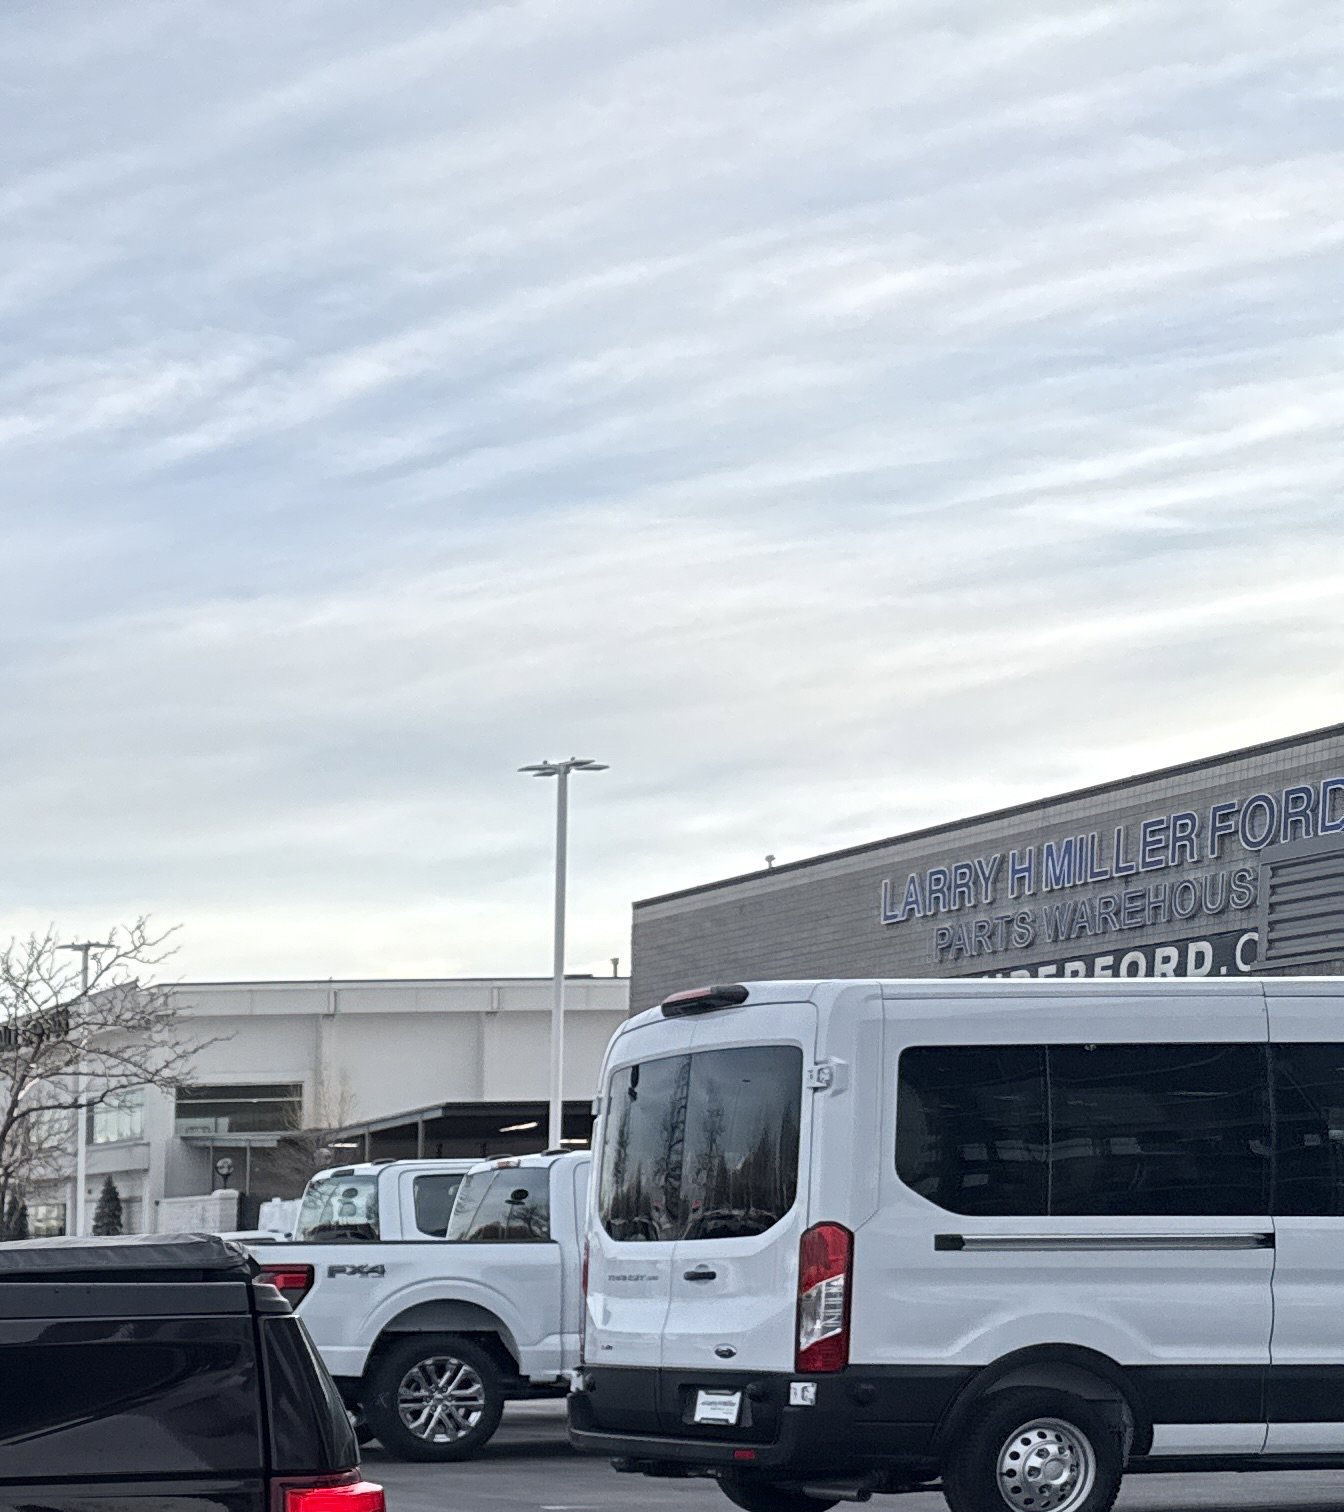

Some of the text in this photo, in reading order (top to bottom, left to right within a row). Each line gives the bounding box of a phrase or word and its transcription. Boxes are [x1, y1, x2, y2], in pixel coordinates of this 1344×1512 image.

[880, 777, 1344, 925] LARRY H MILLER FORD
[931, 866, 1257, 963] PARTS WAREHOUS
[327, 1264, 386, 1279] FX4
